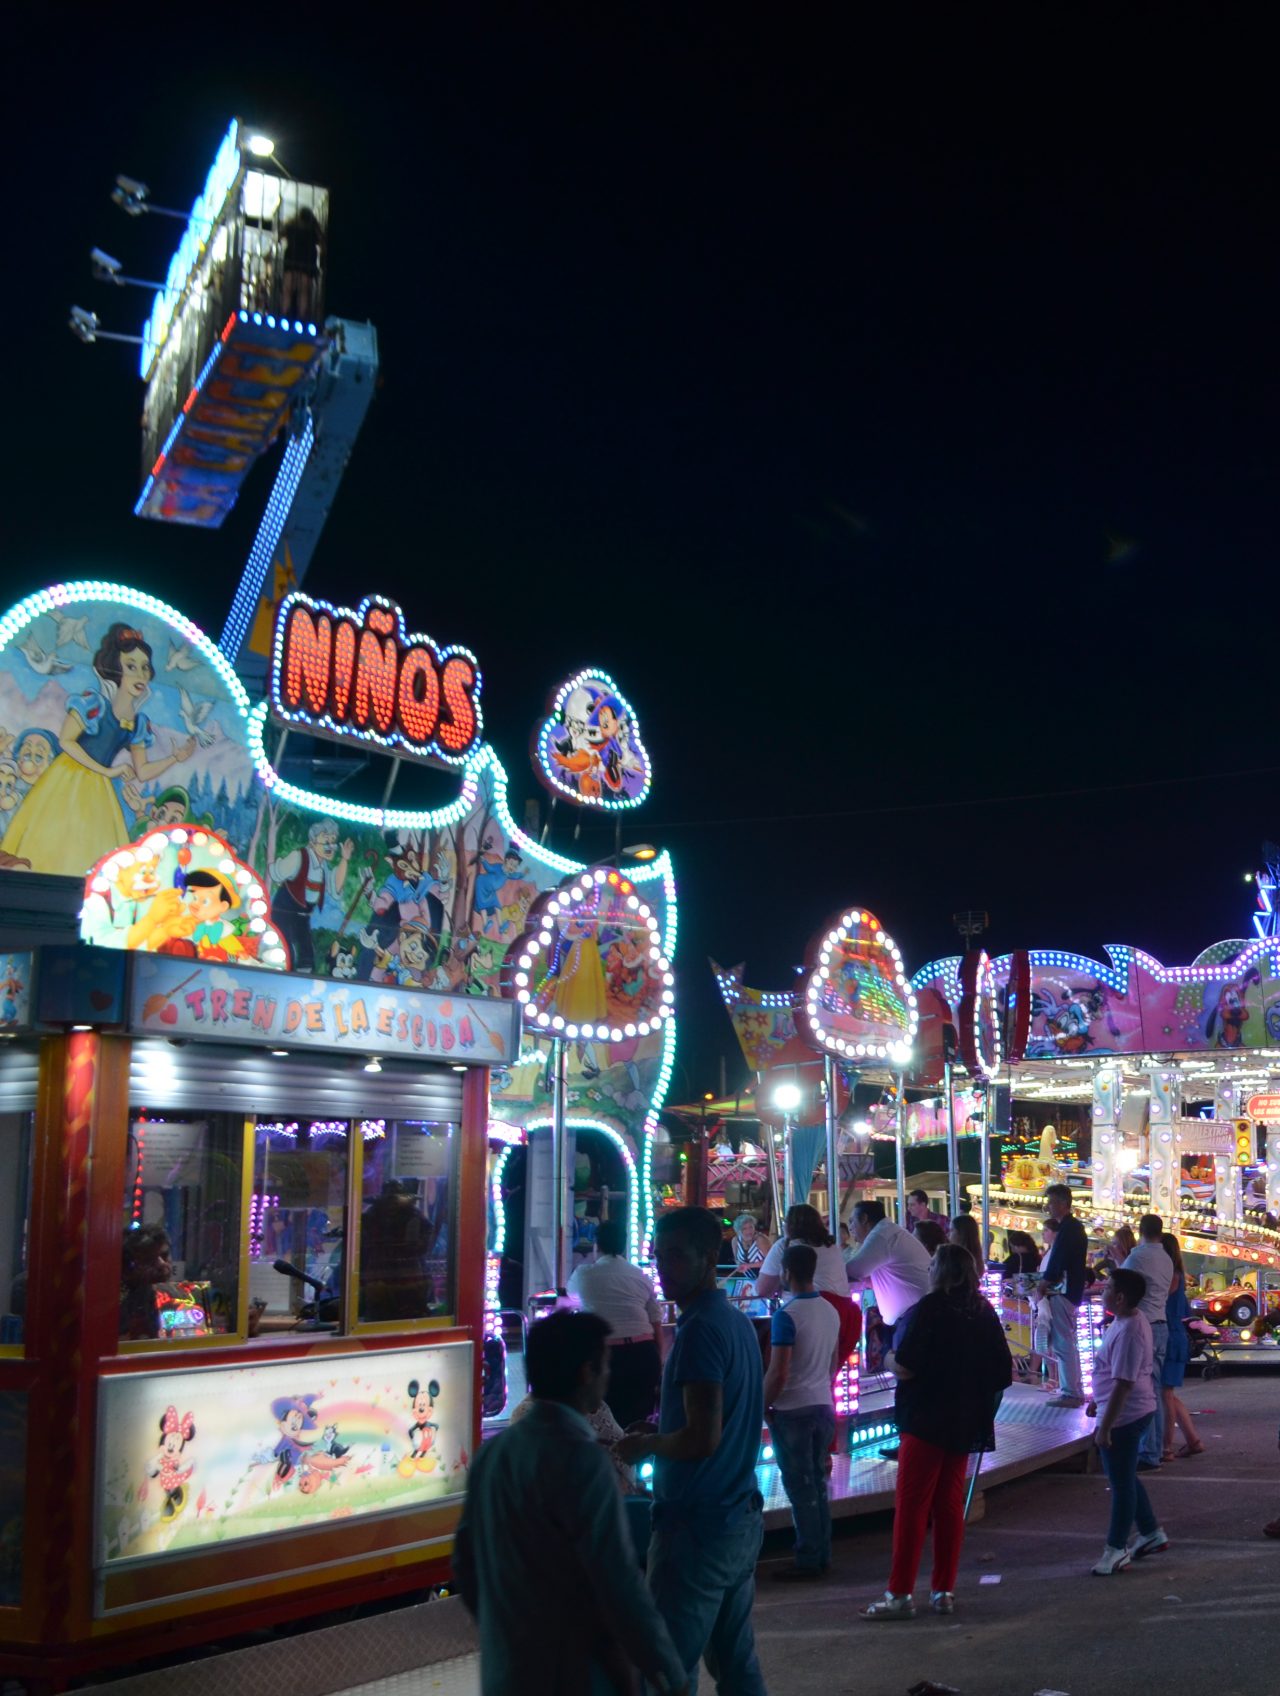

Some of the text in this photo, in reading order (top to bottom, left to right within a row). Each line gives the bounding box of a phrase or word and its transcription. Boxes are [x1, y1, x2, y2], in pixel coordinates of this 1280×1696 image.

[287, 608, 475, 750] NIÑOS
[185, 987, 475, 1050] TREN DE LA ESCOBA
